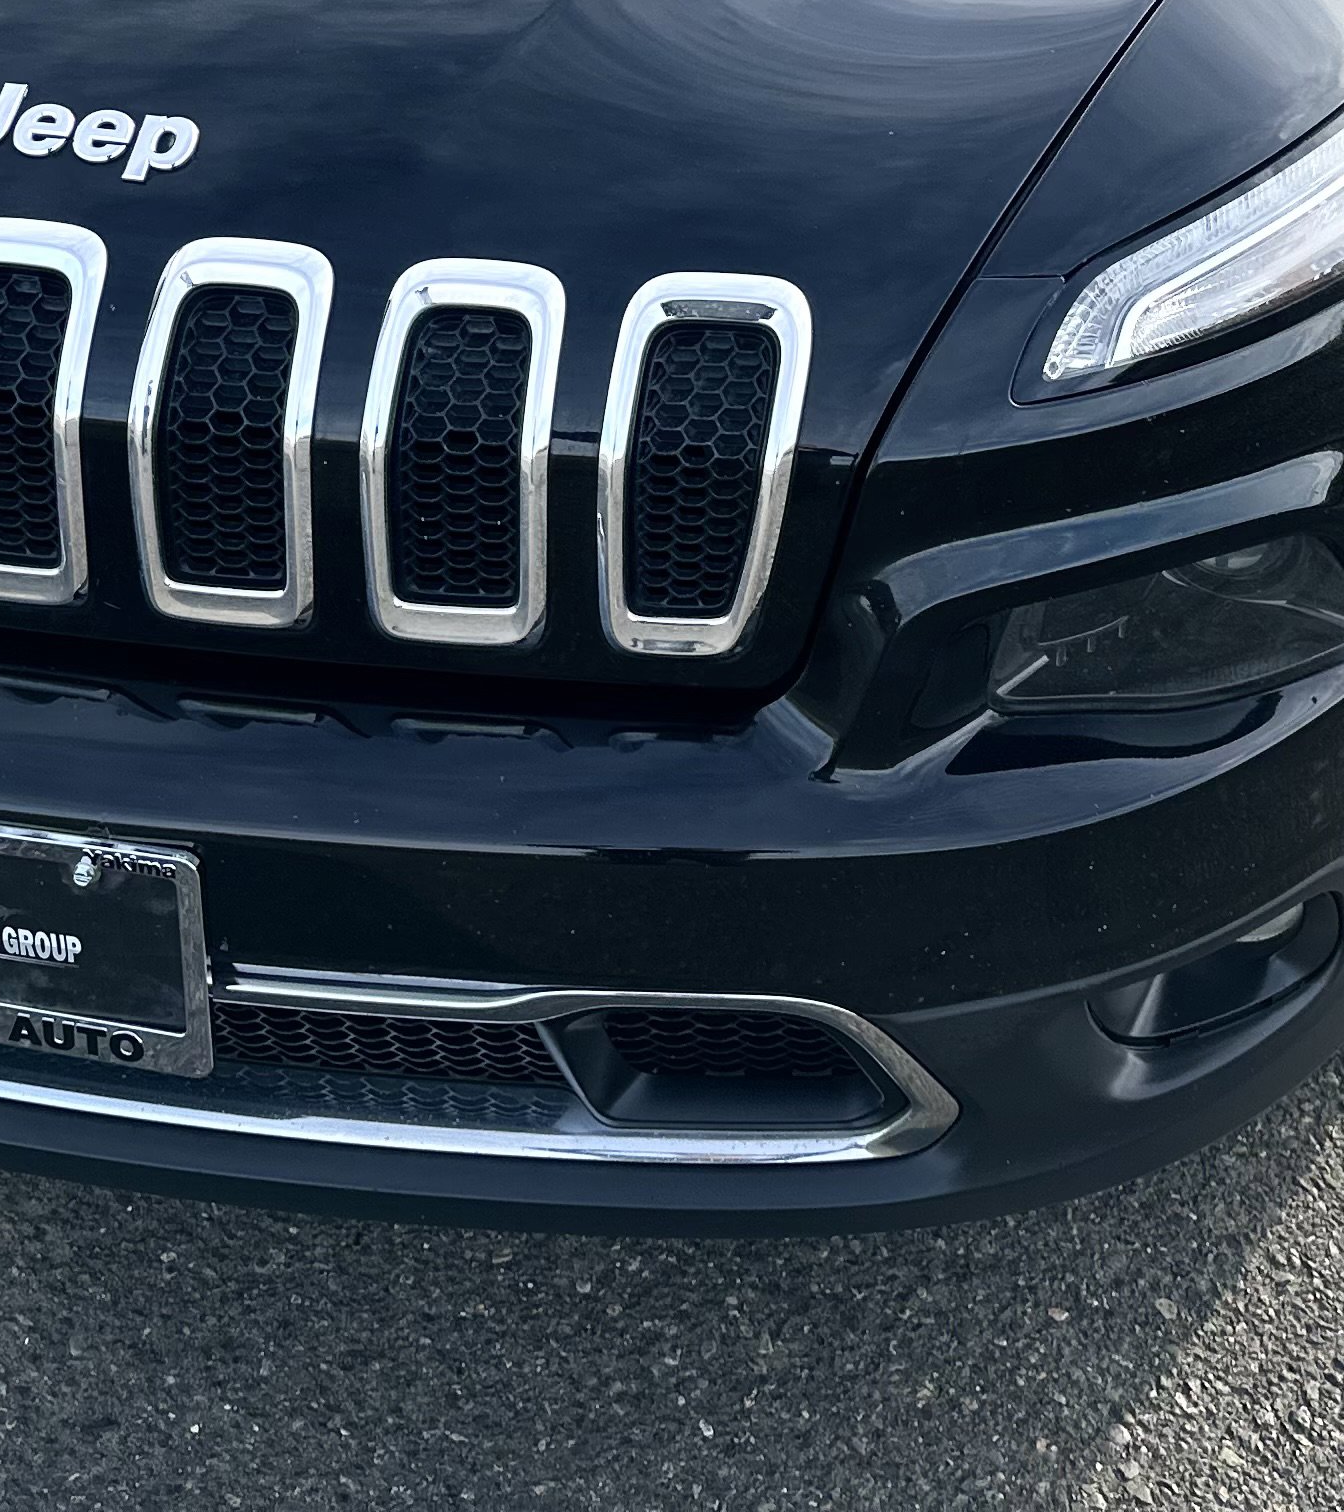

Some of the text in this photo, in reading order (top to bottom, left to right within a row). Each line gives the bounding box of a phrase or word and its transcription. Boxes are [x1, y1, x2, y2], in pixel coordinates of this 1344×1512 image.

[82, 848, 176, 879] Yakima
[2, 926, 82, 963] GROUP
[8, 1012, 145, 1062] AUTO
